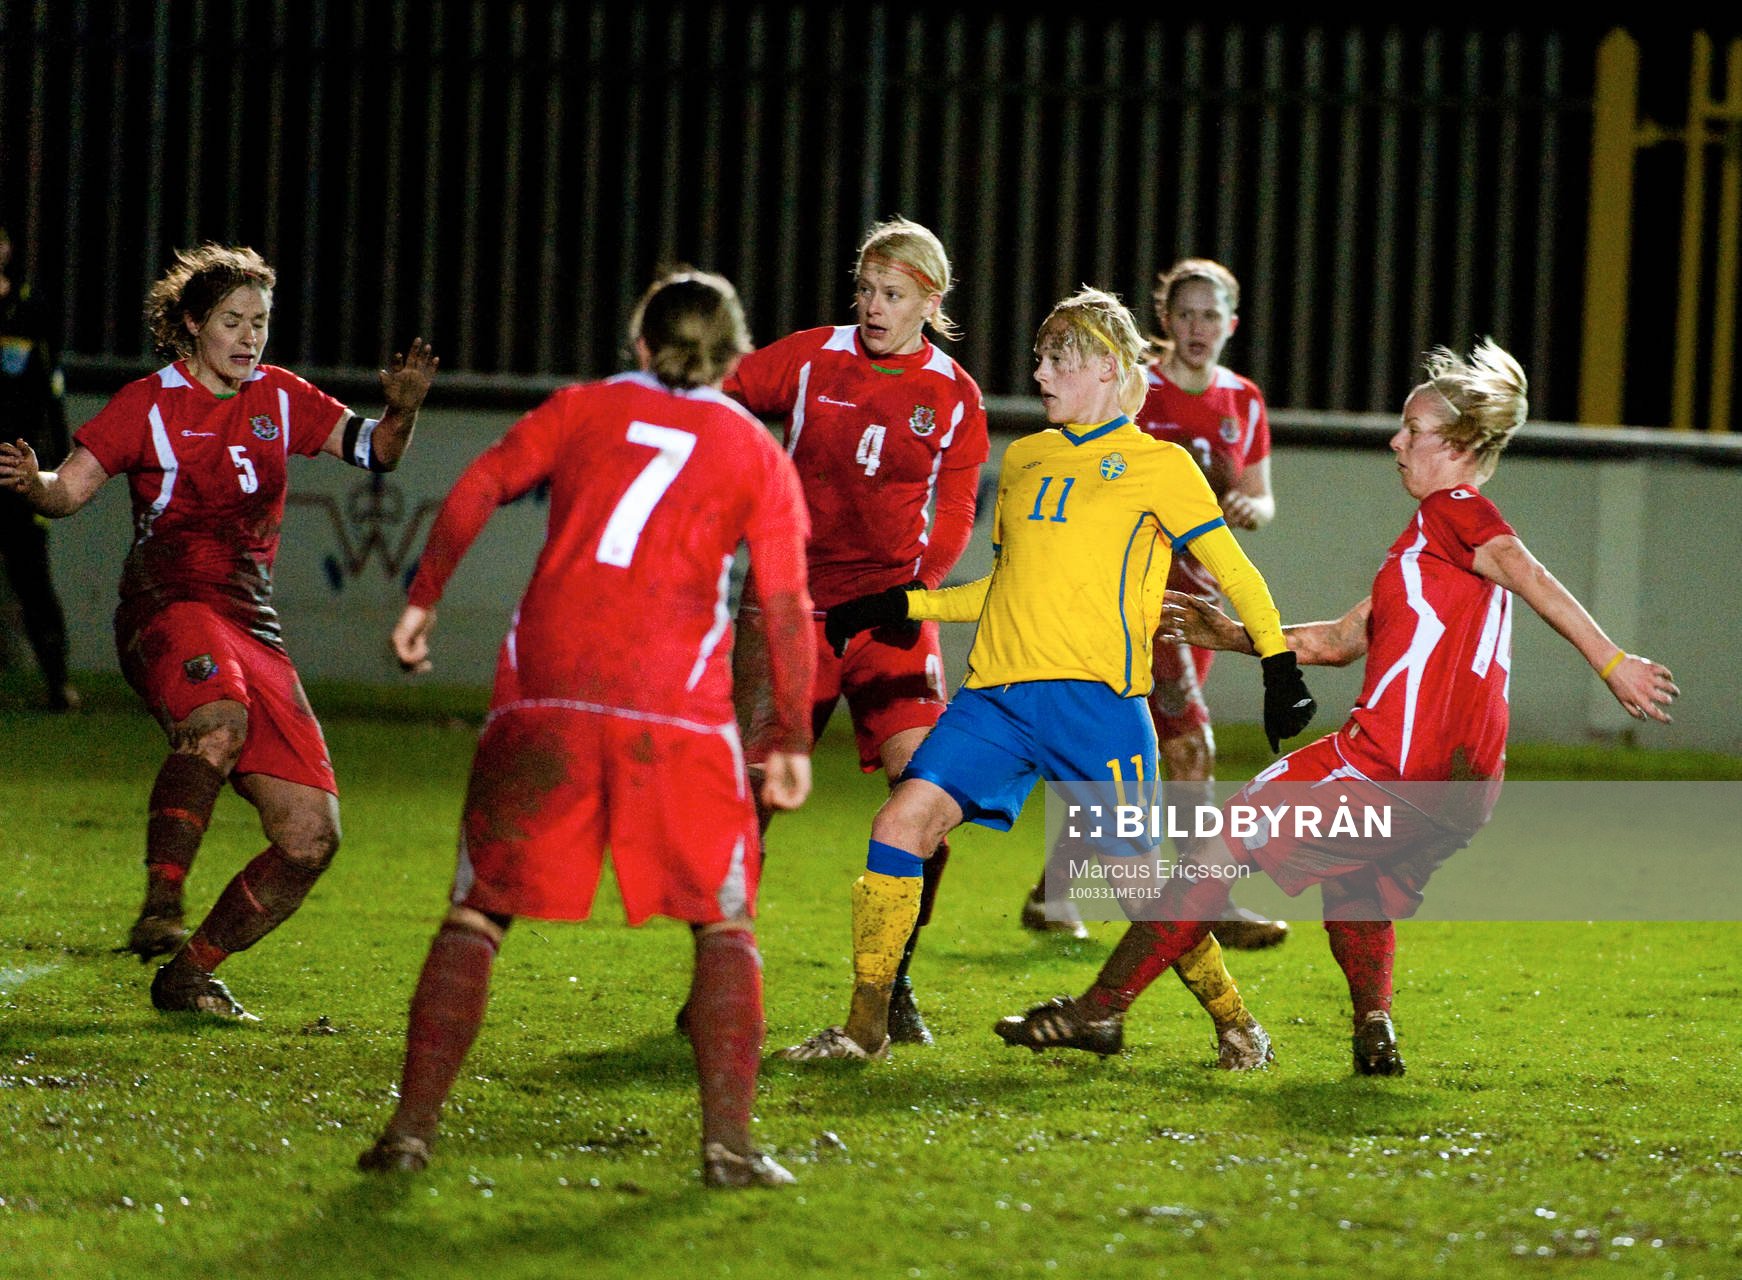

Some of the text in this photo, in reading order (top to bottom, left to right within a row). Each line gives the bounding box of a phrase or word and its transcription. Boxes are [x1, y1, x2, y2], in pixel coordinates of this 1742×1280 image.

[227, 445, 259, 494] 5
[856, 424, 887, 476] 4
[596, 420, 697, 568] 7
[1027, 476, 1076, 523] 11
[1106, 754, 1148, 813] 11
